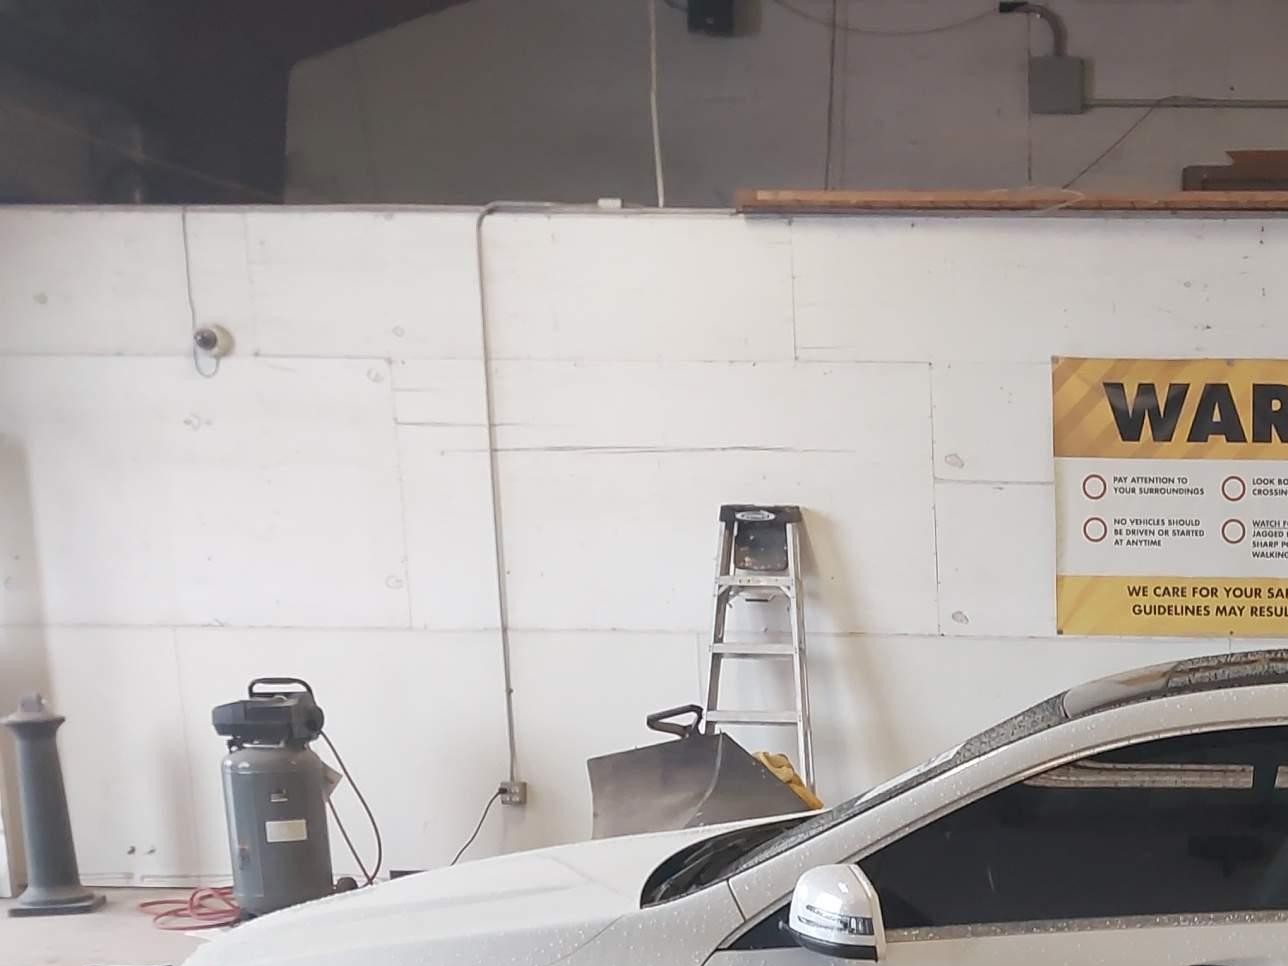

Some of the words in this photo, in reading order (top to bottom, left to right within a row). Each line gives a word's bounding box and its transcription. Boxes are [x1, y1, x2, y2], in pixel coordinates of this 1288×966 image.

[1252, 520, 1280, 528] WATCH
[1128, 586, 1148, 597] WE
[1153, 586, 1187, 598] CARE
[1192, 587, 1218, 598] FOR
[1223, 587, 1262, 599] YOUR
[1132, 605, 1210, 616] GUIDELINES
[1215, 605, 1245, 616] MAY
